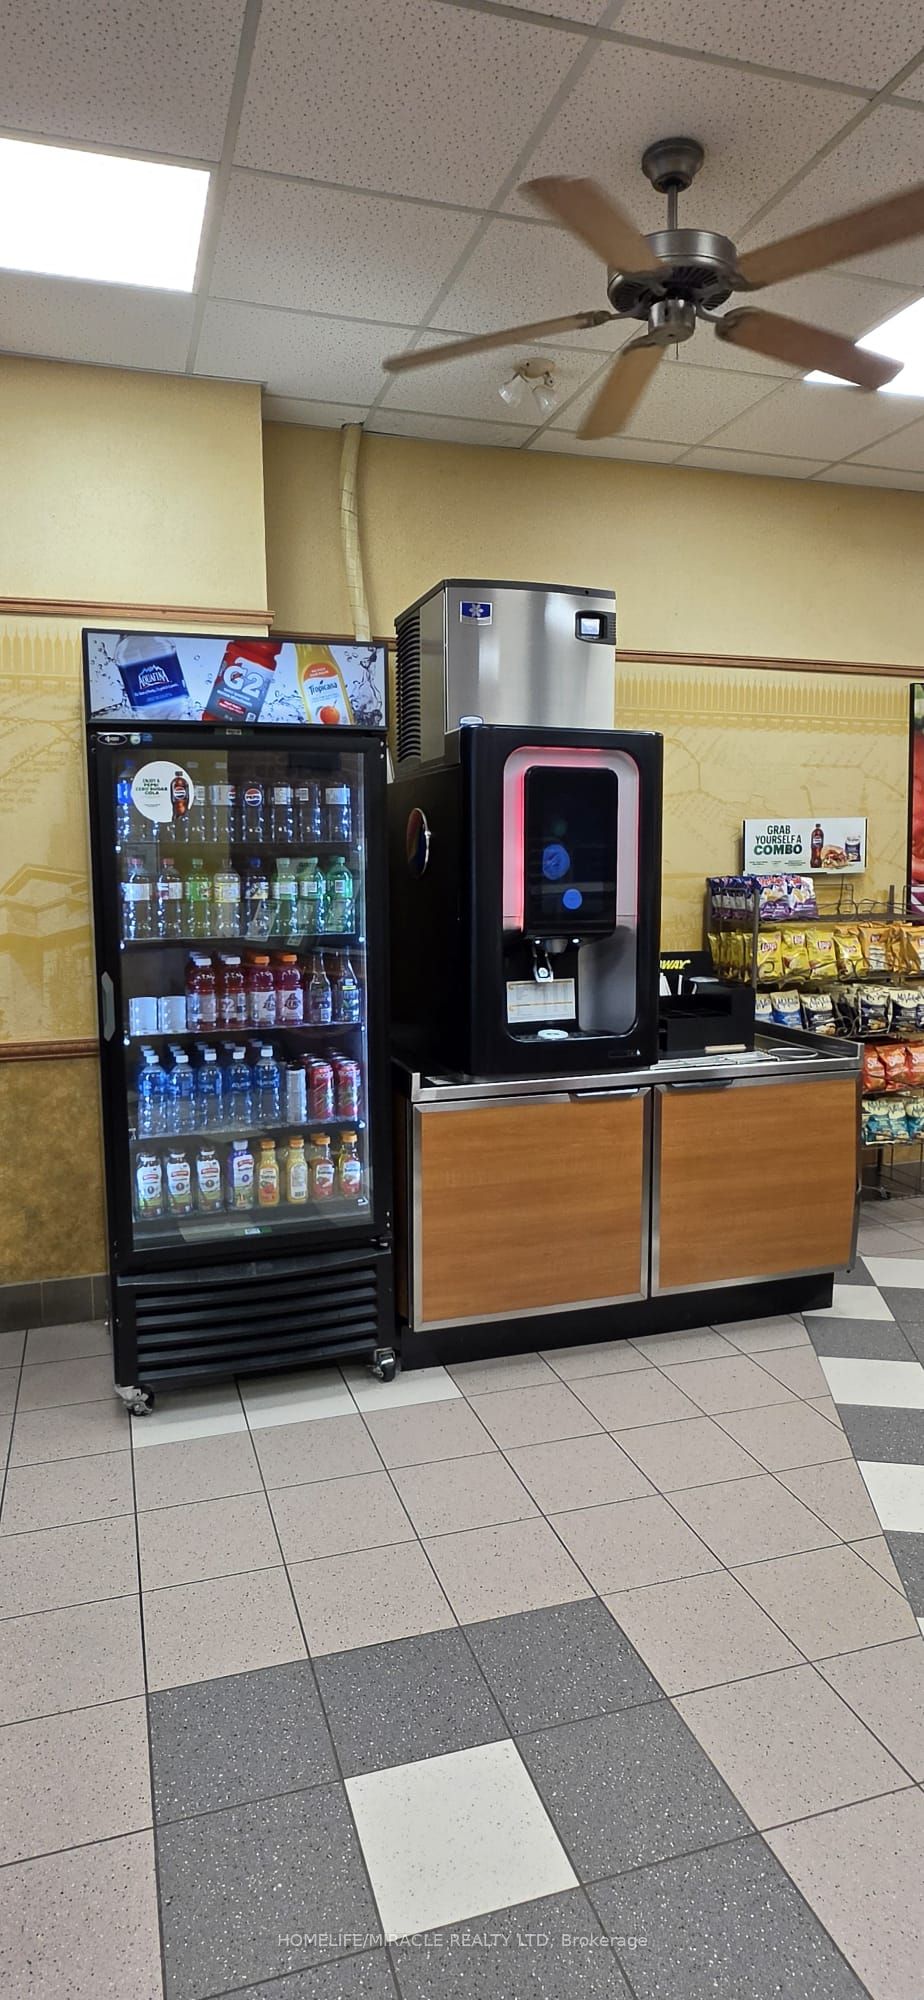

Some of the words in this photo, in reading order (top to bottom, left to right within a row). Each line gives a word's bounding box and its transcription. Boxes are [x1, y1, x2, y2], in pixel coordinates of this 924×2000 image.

[223, 665, 264, 698] G2
[309, 681, 338, 695] Tropicana
[767, 825, 791, 835] GRAB
[755, 835, 796, 845] YOURSELF
[796, 835, 802, 844] A
[753, 844, 803, 855] COMBO
[660, 959, 690, 970] WAY
